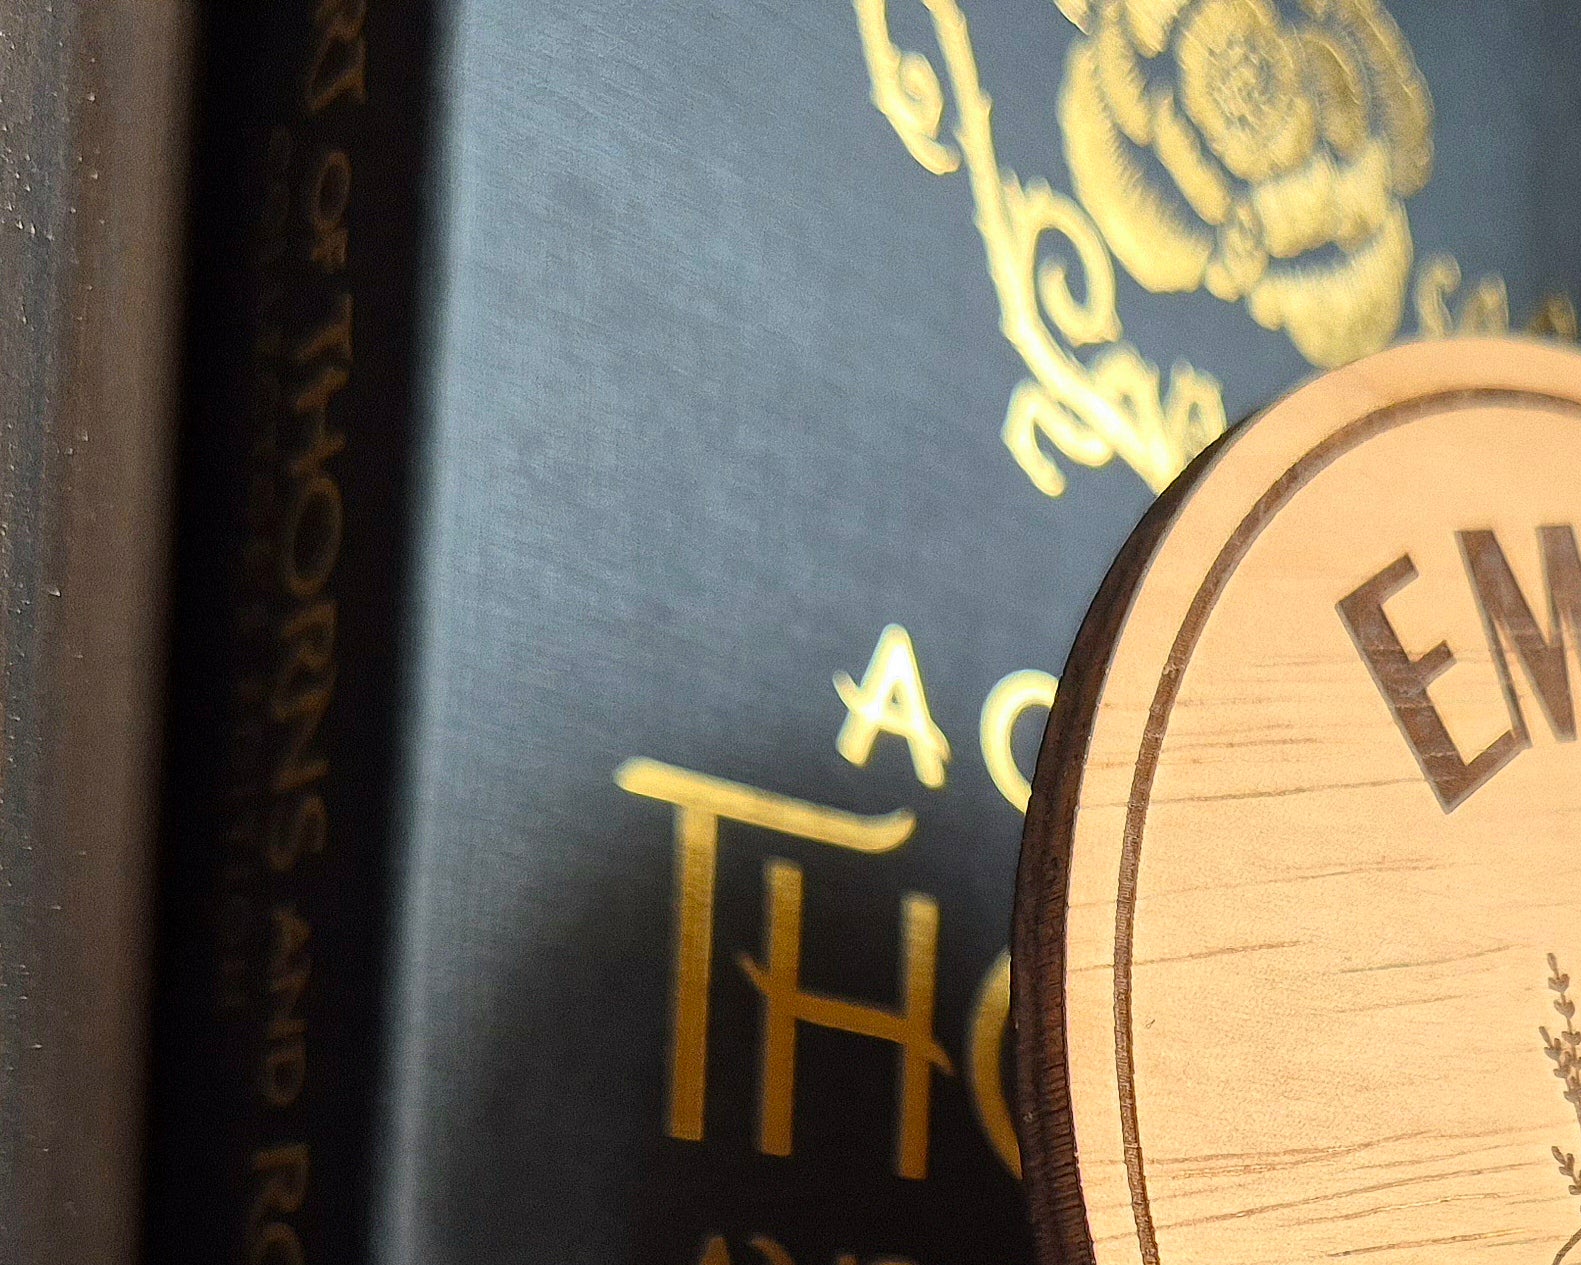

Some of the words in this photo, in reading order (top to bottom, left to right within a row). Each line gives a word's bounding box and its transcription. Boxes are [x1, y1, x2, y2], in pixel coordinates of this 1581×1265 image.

[309, 147, 352, 272] OF
[266, 292, 354, 873] THORNS
[831, 621, 952, 789] A
[261, 905, 312, 1110] AND
